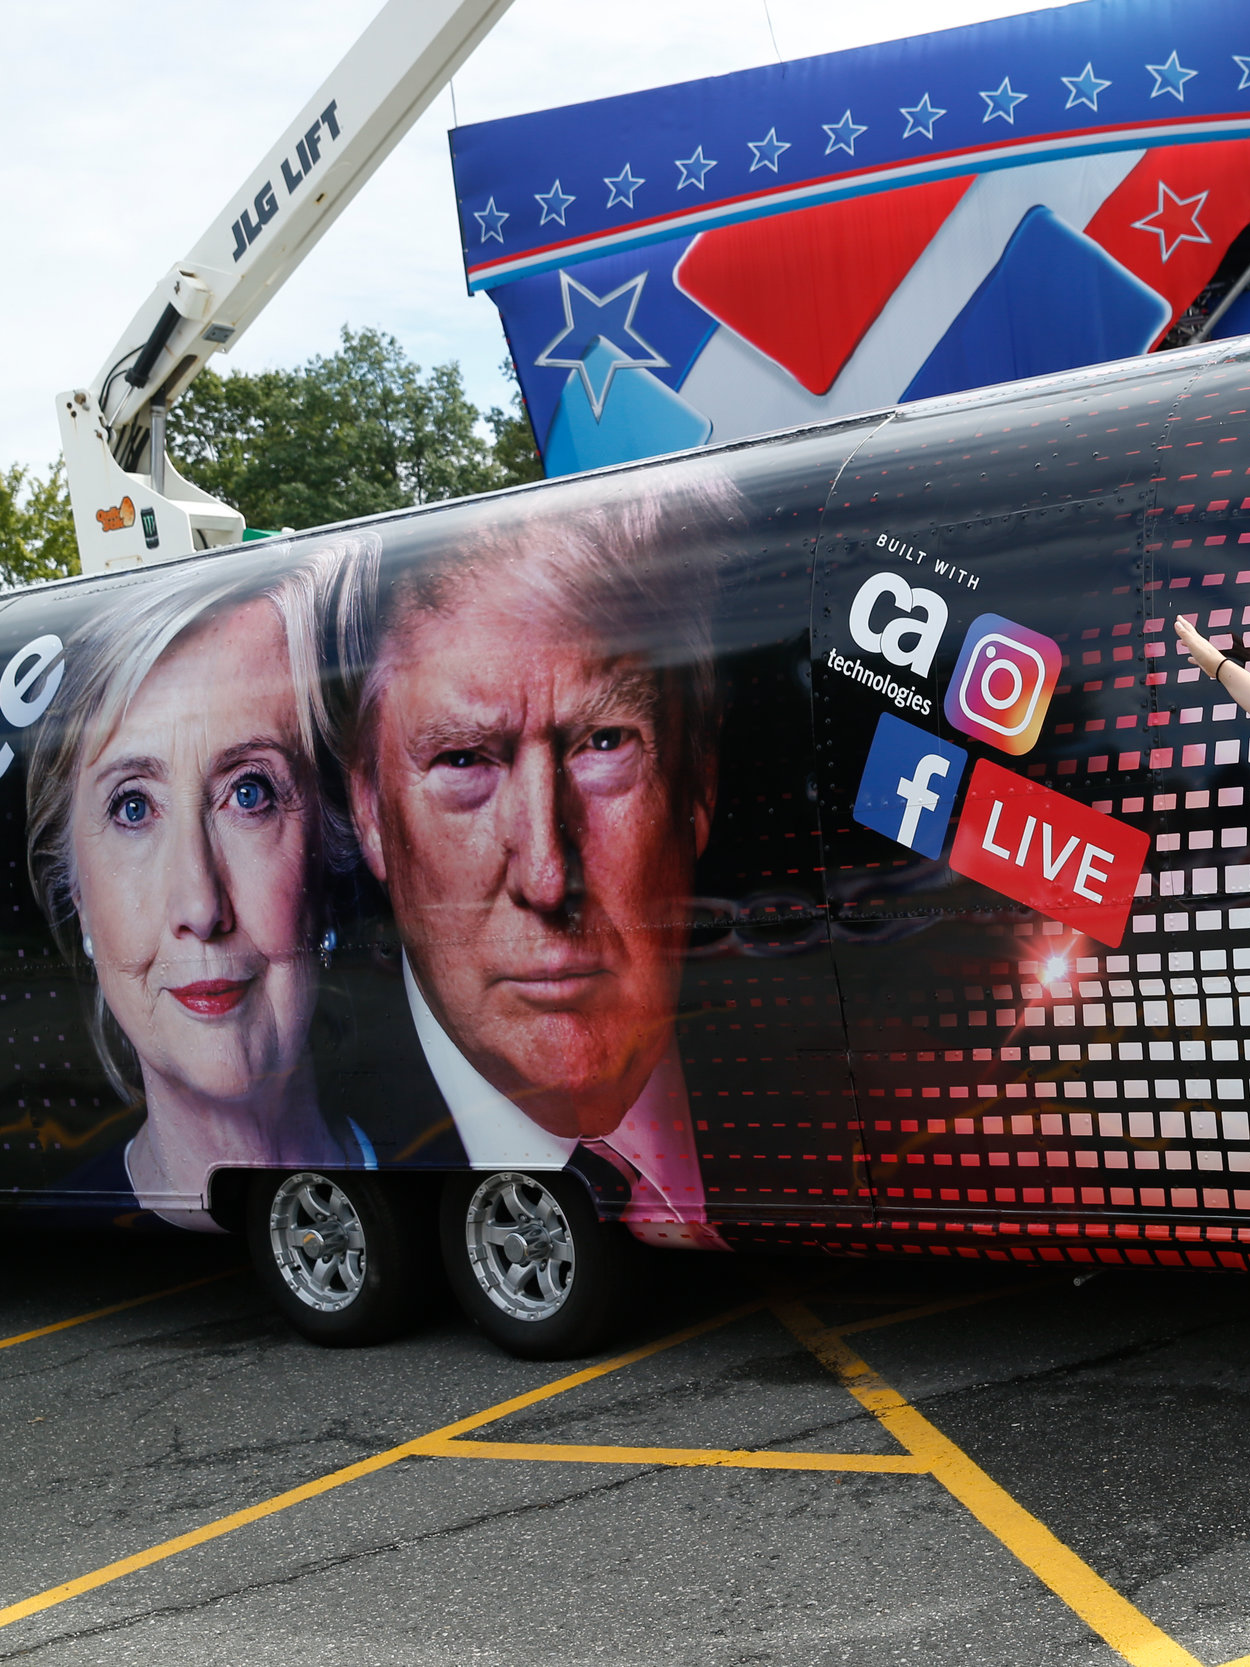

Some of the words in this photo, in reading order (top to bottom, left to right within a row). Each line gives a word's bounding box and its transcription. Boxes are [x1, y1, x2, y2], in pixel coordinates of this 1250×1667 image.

[231, 180, 279, 263] JLG
[280, 98, 341, 195] LIFT
[876, 534, 927, 565] BUILT
[934, 559, 981, 591] WITH
[849, 571, 949, 679] ca
[827, 647, 932, 716] technologies
[981, 799, 1115, 904] LIVE
